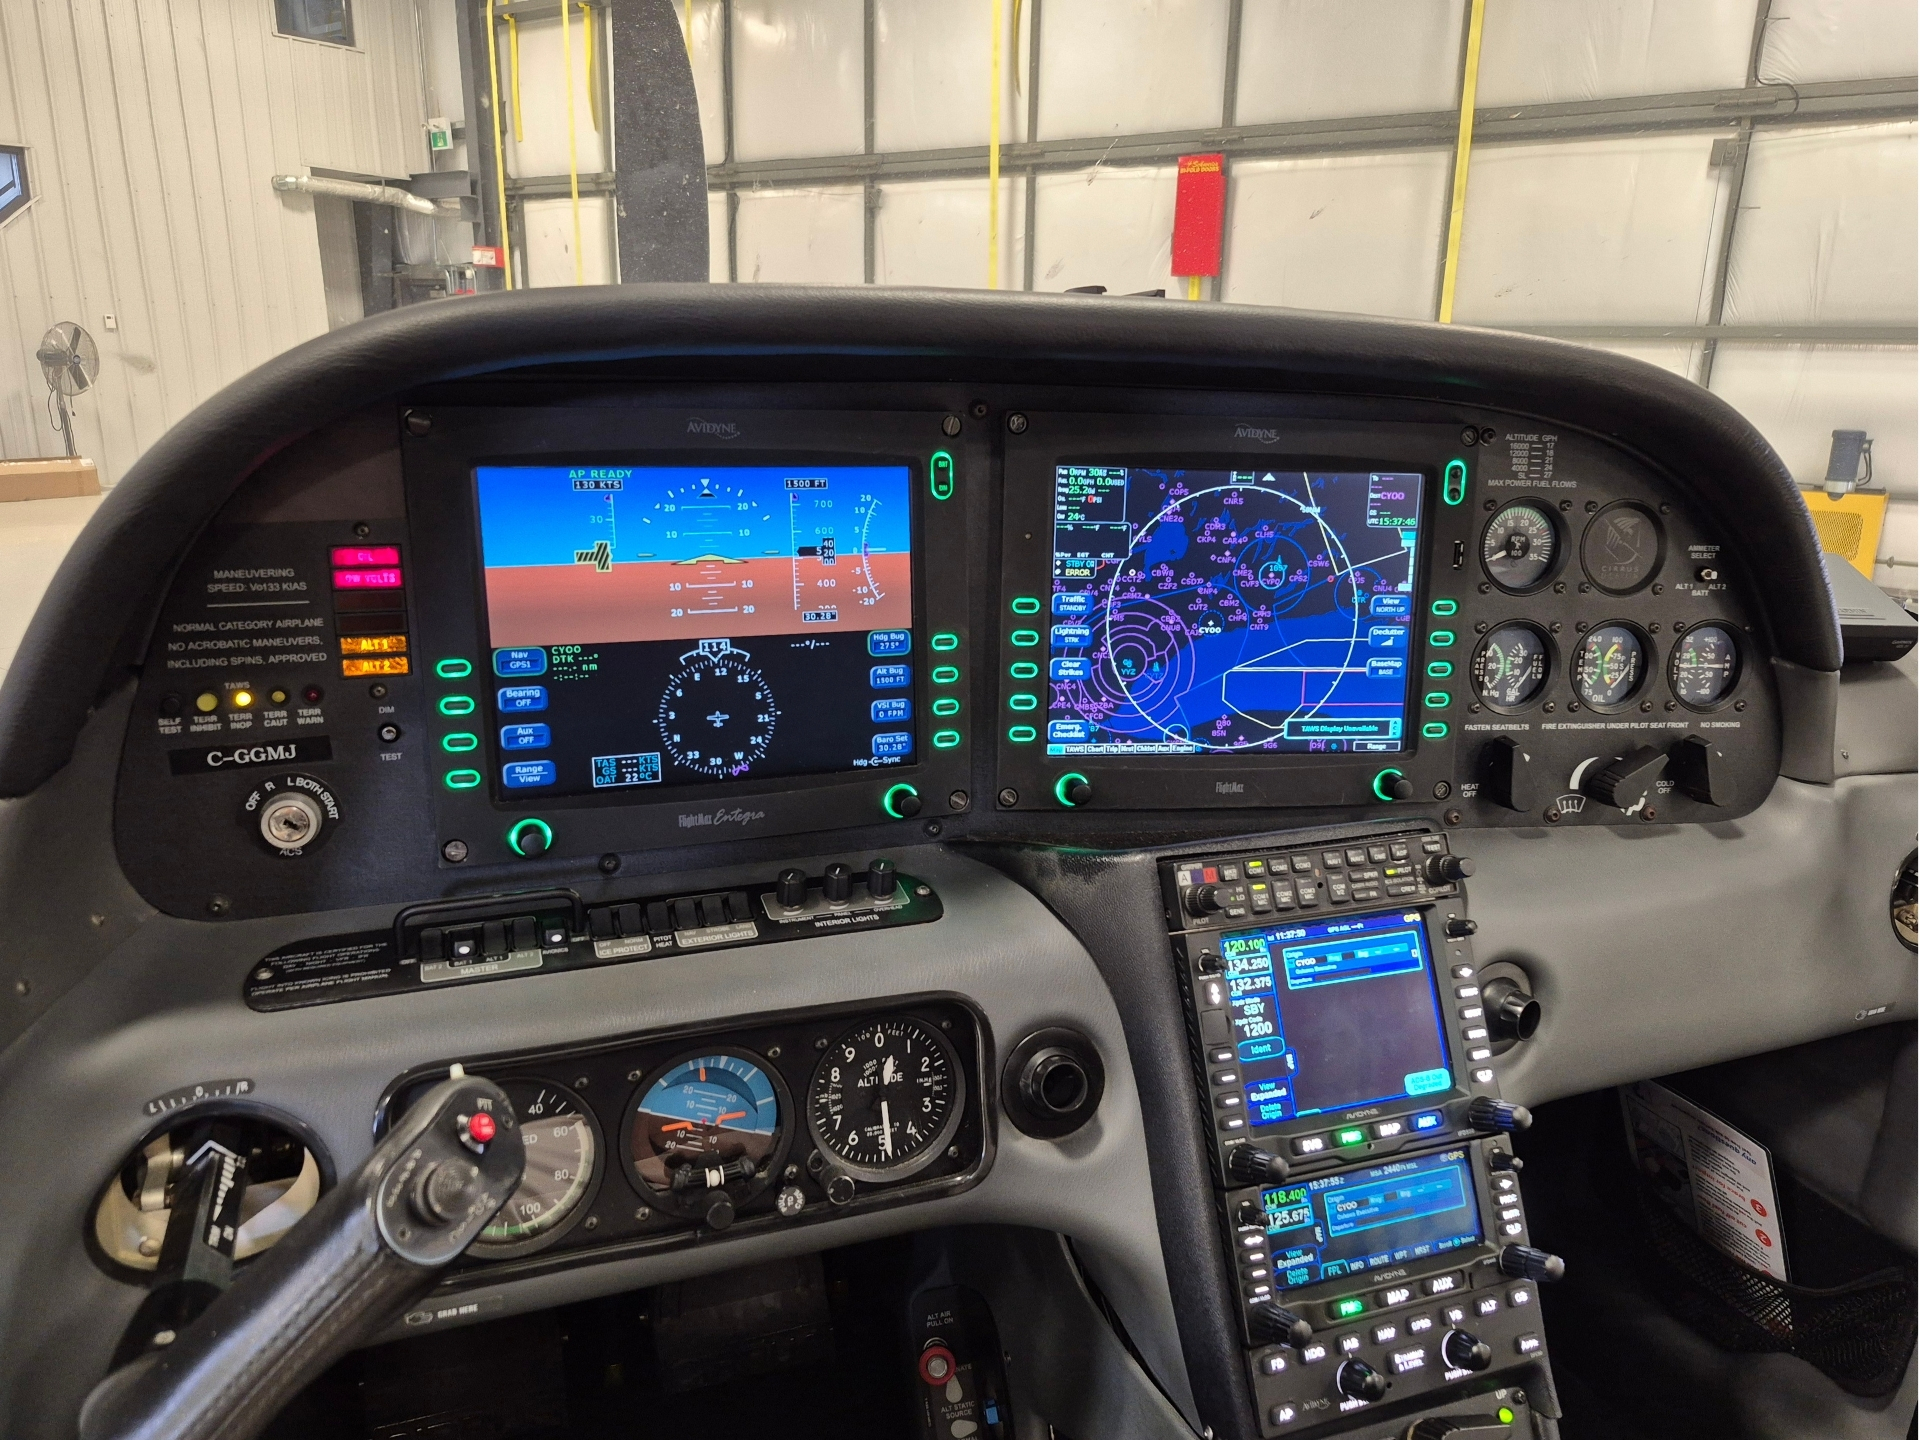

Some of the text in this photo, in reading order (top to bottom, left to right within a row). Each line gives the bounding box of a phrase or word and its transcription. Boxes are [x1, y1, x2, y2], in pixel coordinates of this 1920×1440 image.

[687, 421, 736, 434] AVIDYNE
[1234, 427, 1277, 438] AVIDYNE
[1505, 433, 1539, 441] ALTITUDE
[569, 470, 632, 478] AP READY
[575, 480, 620, 489] 130 KTS
[786, 479, 827, 488] 1500 FT
[1488, 479, 1506, 487] MAX
[814, 527, 834, 535] 600
[213, 568, 295, 580] MANEUVERING
[207, 581, 307, 593] SPEED: Vo133 KIAS
[817, 579, 836, 587] 400
[805, 612, 836, 620] 30.28"
[173, 618, 324, 632] NORMAL CATEGORY AIRPLANE
[873, 632, 905, 642] Hdg Bug
[1055, 628, 1089, 637] Lightning
[168, 636, 324, 652] NO ACROBATIC MANEUVERS,
[361, 639, 388, 650] ALT 1
[552, 645, 581, 654] CYOO
[703, 642, 727, 651] 114
[167, 652, 327, 669] INCLUDING SPINS, APPROVED
[511, 651, 528, 659] Nav
[552, 655, 574, 663] DTK
[362, 660, 391, 671] ALT 2
[509, 661, 531, 669] GPS1
[1371, 660, 1403, 668] BaseMap
[876, 667, 903, 675] Alt Bug
[876, 676, 894, 684] 1500
[506, 689, 540, 698] Bearing
[515, 699, 531, 707] OFF
[891, 701, 905, 709] Bug
[378, 705, 395, 714] DIM
[887, 709, 904, 717] FPM
[1667, 721, 1689, 729] FRONT
[517, 727, 533, 735] Aux
[518, 736, 534, 744] OFF
[876, 734, 908, 743] Baro Set
[207, 744, 297, 767] C-GGMJ
[380, 752, 402, 761] TEST
[596, 755, 658, 767] TAS KTS
[853, 755, 901, 766] Hdg Sync
[515, 765, 543, 774] Range
[602, 764, 658, 775] GS KTS
[519, 774, 541, 783] View
[596, 775, 616, 784] OAT
[1656, 780, 1674, 788] COLD
[1461, 783, 1479, 791] HEAT
[245, 777, 339, 820] OFF R L BOTH START
[1463, 790, 1477, 798] OFF
[815, 914, 879, 928] INTERIOR LIGHTS
[682, 930, 754, 945] EXTERIOR LIGHTS
[1224, 939, 1265, 953] 120.100
[460, 964, 499, 975] MASTER
[1228, 958, 1269, 972] 134.250
[1230, 976, 1272, 991] 132.375
[1243, 1003, 1265, 1015] SBY
[1244, 1021, 1273, 1037] 1200
[874, 1032, 884, 1047] 0
[845, 1047, 856, 1062] 9
[1251, 1044, 1271, 1054] Ident
[921, 1057, 930, 1072] 2
[831, 1067, 840, 1082] 8
[1259, 1082, 1276, 1091] View
[1250, 1087, 1287, 1101] Expanded
[528, 1103, 544, 1115] 40
[922, 1097, 931, 1113] 3
[832, 1115, 842, 1130] 7
[906, 1121, 917, 1135] 4
[553, 1126, 569, 1137] 60
[848, 1130, 859, 1146] 6
[878, 1135, 887, 1150] 5
[554, 1169, 569, 1181] 80
[1264, 1188, 1307, 1206] 118.400
[520, 1203, 541, 1215] 100
[1337, 1201, 1358, 1212] CYOO
[1269, 1207, 1310, 1226] 125.675
[1433, 1277, 1455, 1293] AUX
[1387, 1289, 1409, 1305] MAP
[459, 1304, 479, 1315] HERE
[927, 1310, 951, 1321] ALT AIR
[926, 1317, 954, 1328] PULL ON
[1495, 1389, 1507, 1399] UP
[940, 1400, 975, 1413] ALT STATIC
[945, 1408, 973, 1419] SOURCE
